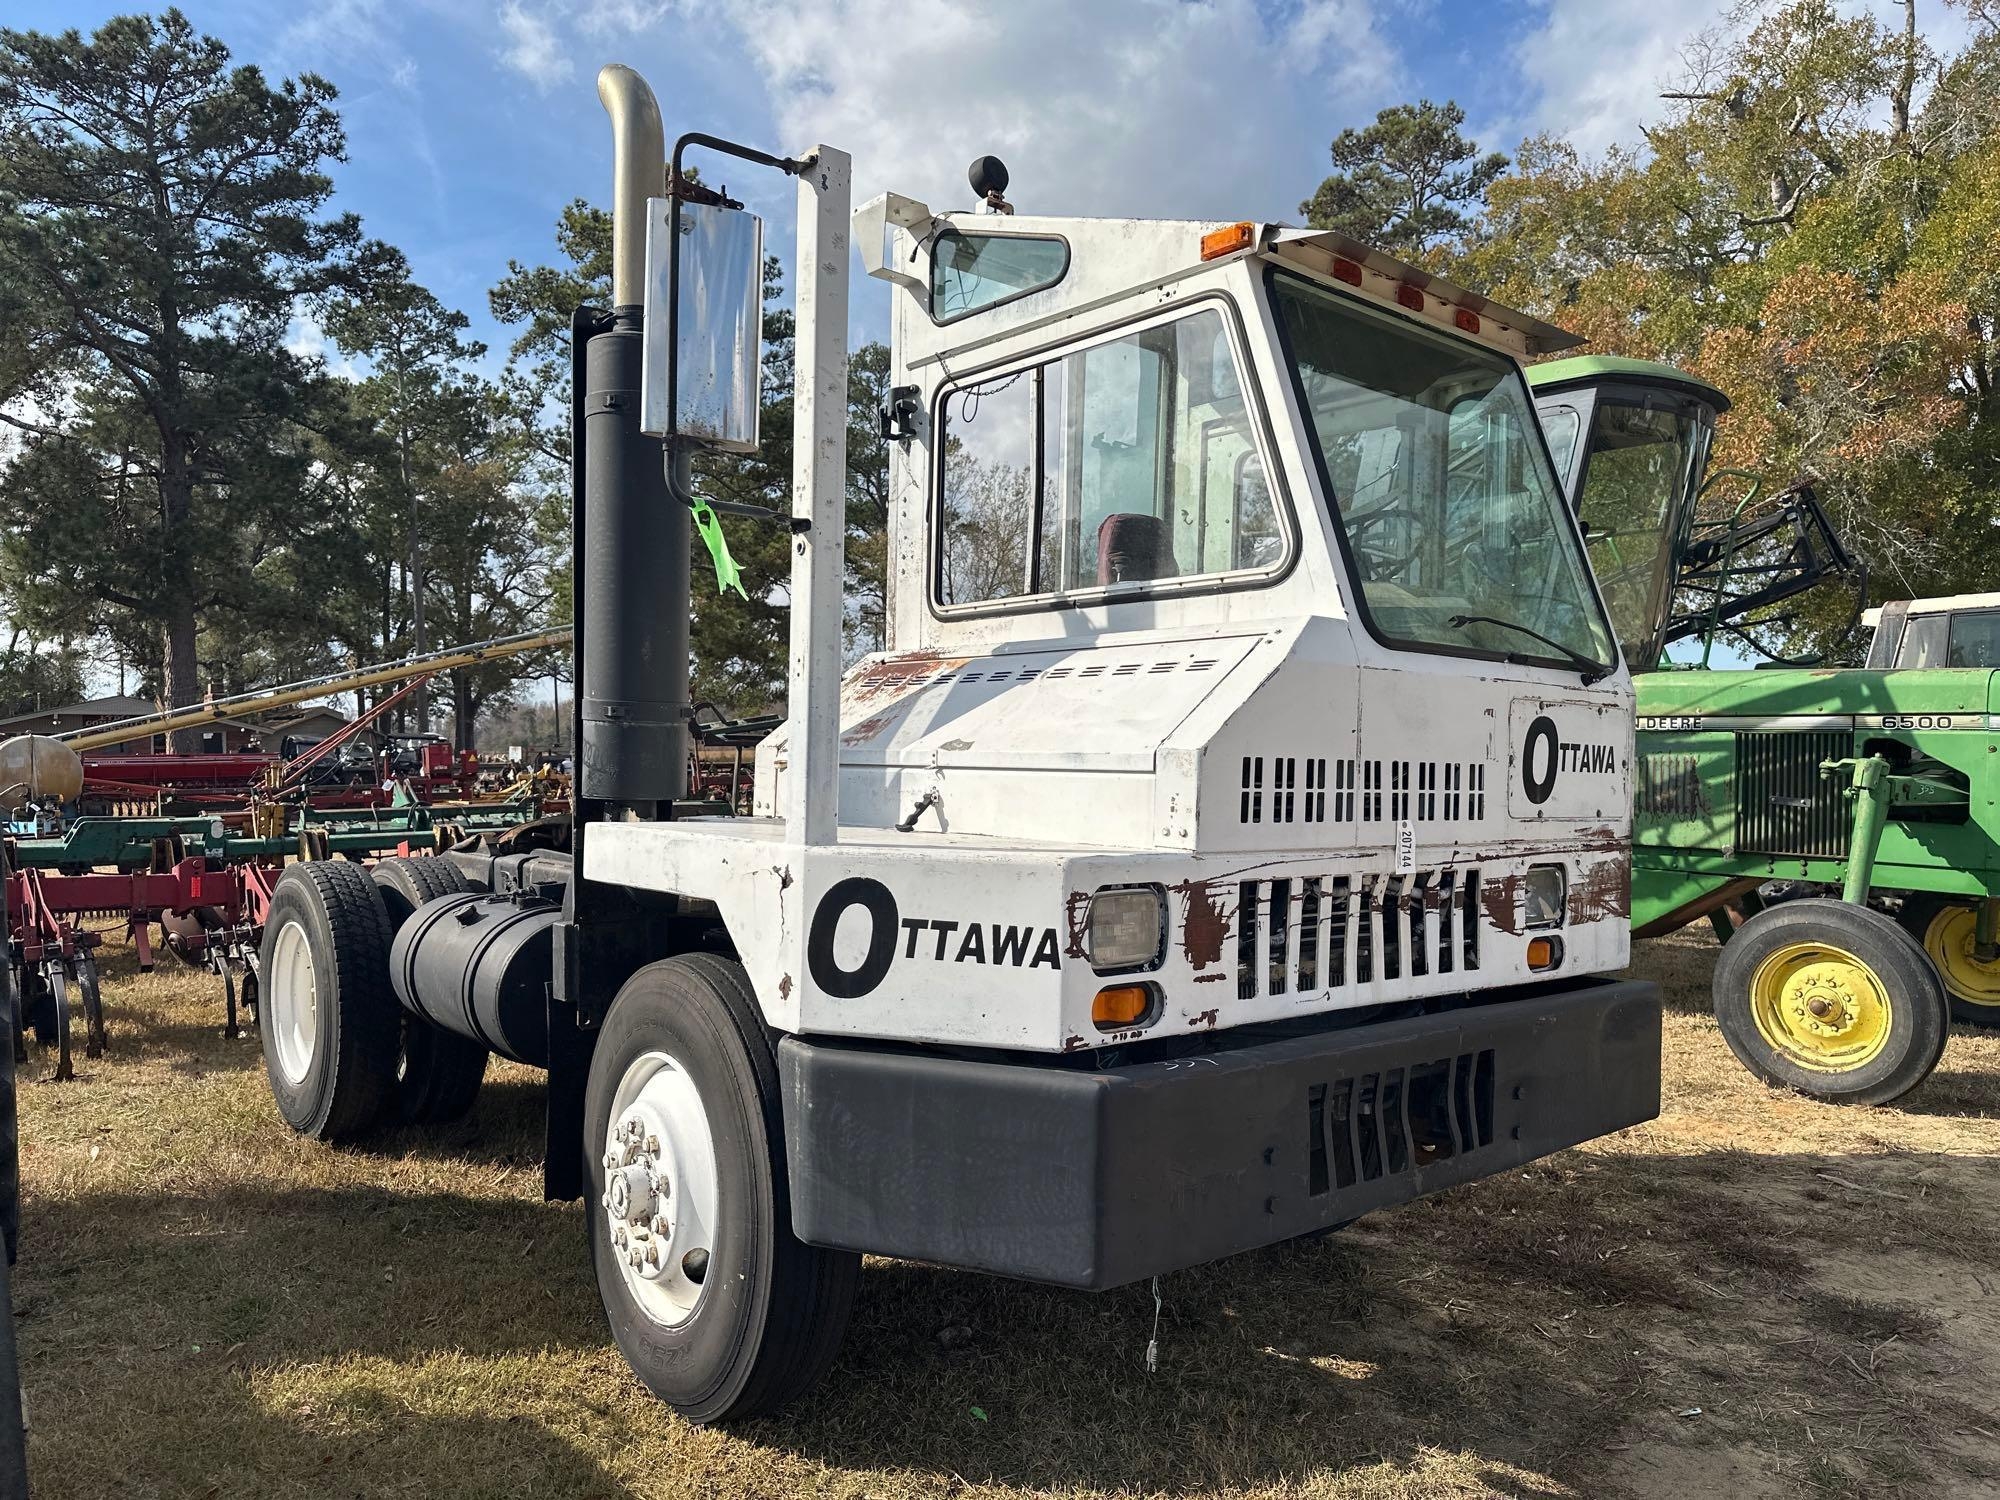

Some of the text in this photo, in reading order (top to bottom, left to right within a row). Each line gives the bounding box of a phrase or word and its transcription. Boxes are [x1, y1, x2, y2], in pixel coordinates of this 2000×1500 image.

[1646, 717, 1702, 729] DEERE
[1881, 716, 1952, 729] 6500
[1523, 716, 1615, 804] OTTAWA
[1401, 831, 1412, 868] 207144
[807, 876, 1061, 999] OTTAWA
